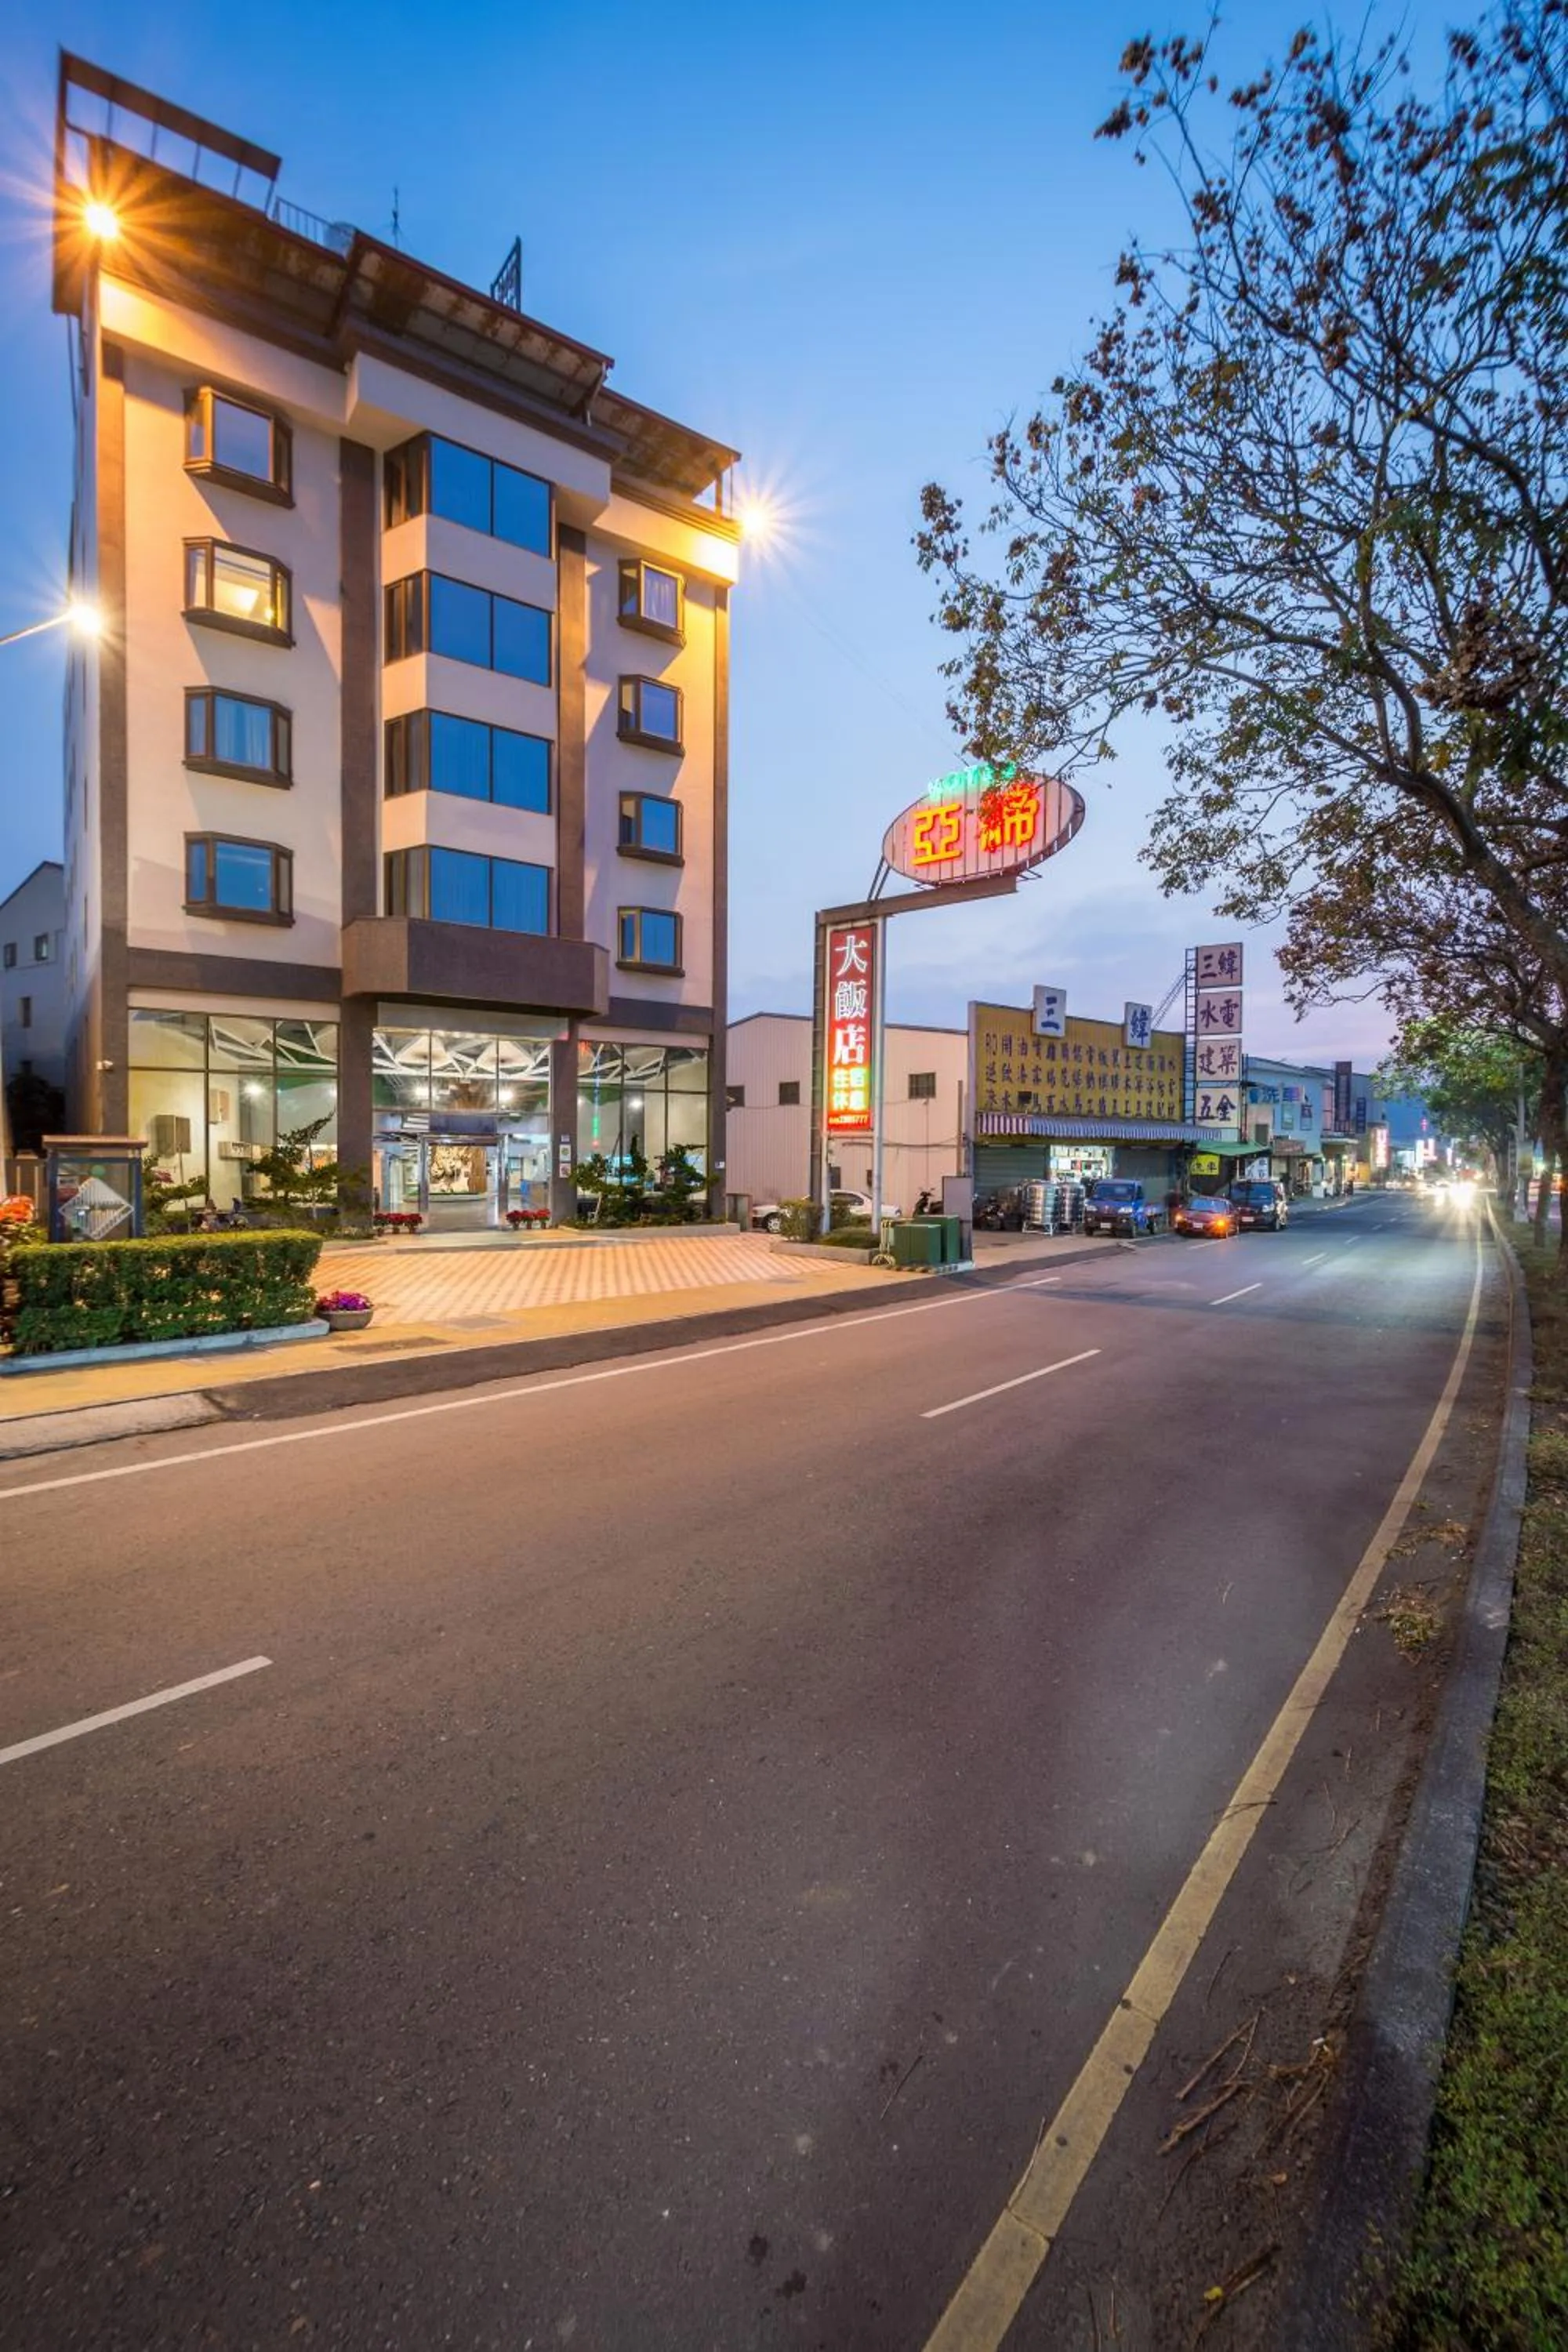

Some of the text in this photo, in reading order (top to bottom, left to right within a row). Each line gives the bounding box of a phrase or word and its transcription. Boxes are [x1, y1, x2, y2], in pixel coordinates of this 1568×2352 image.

[1200, 949, 1238, 979] 三緯
[833, 935, 868, 1065] 大飯店
[1200, 998, 1240, 1029] 水電
[1199, 1044, 1238, 1076] 建築
[1198, 1094, 1236, 1122] 五金
